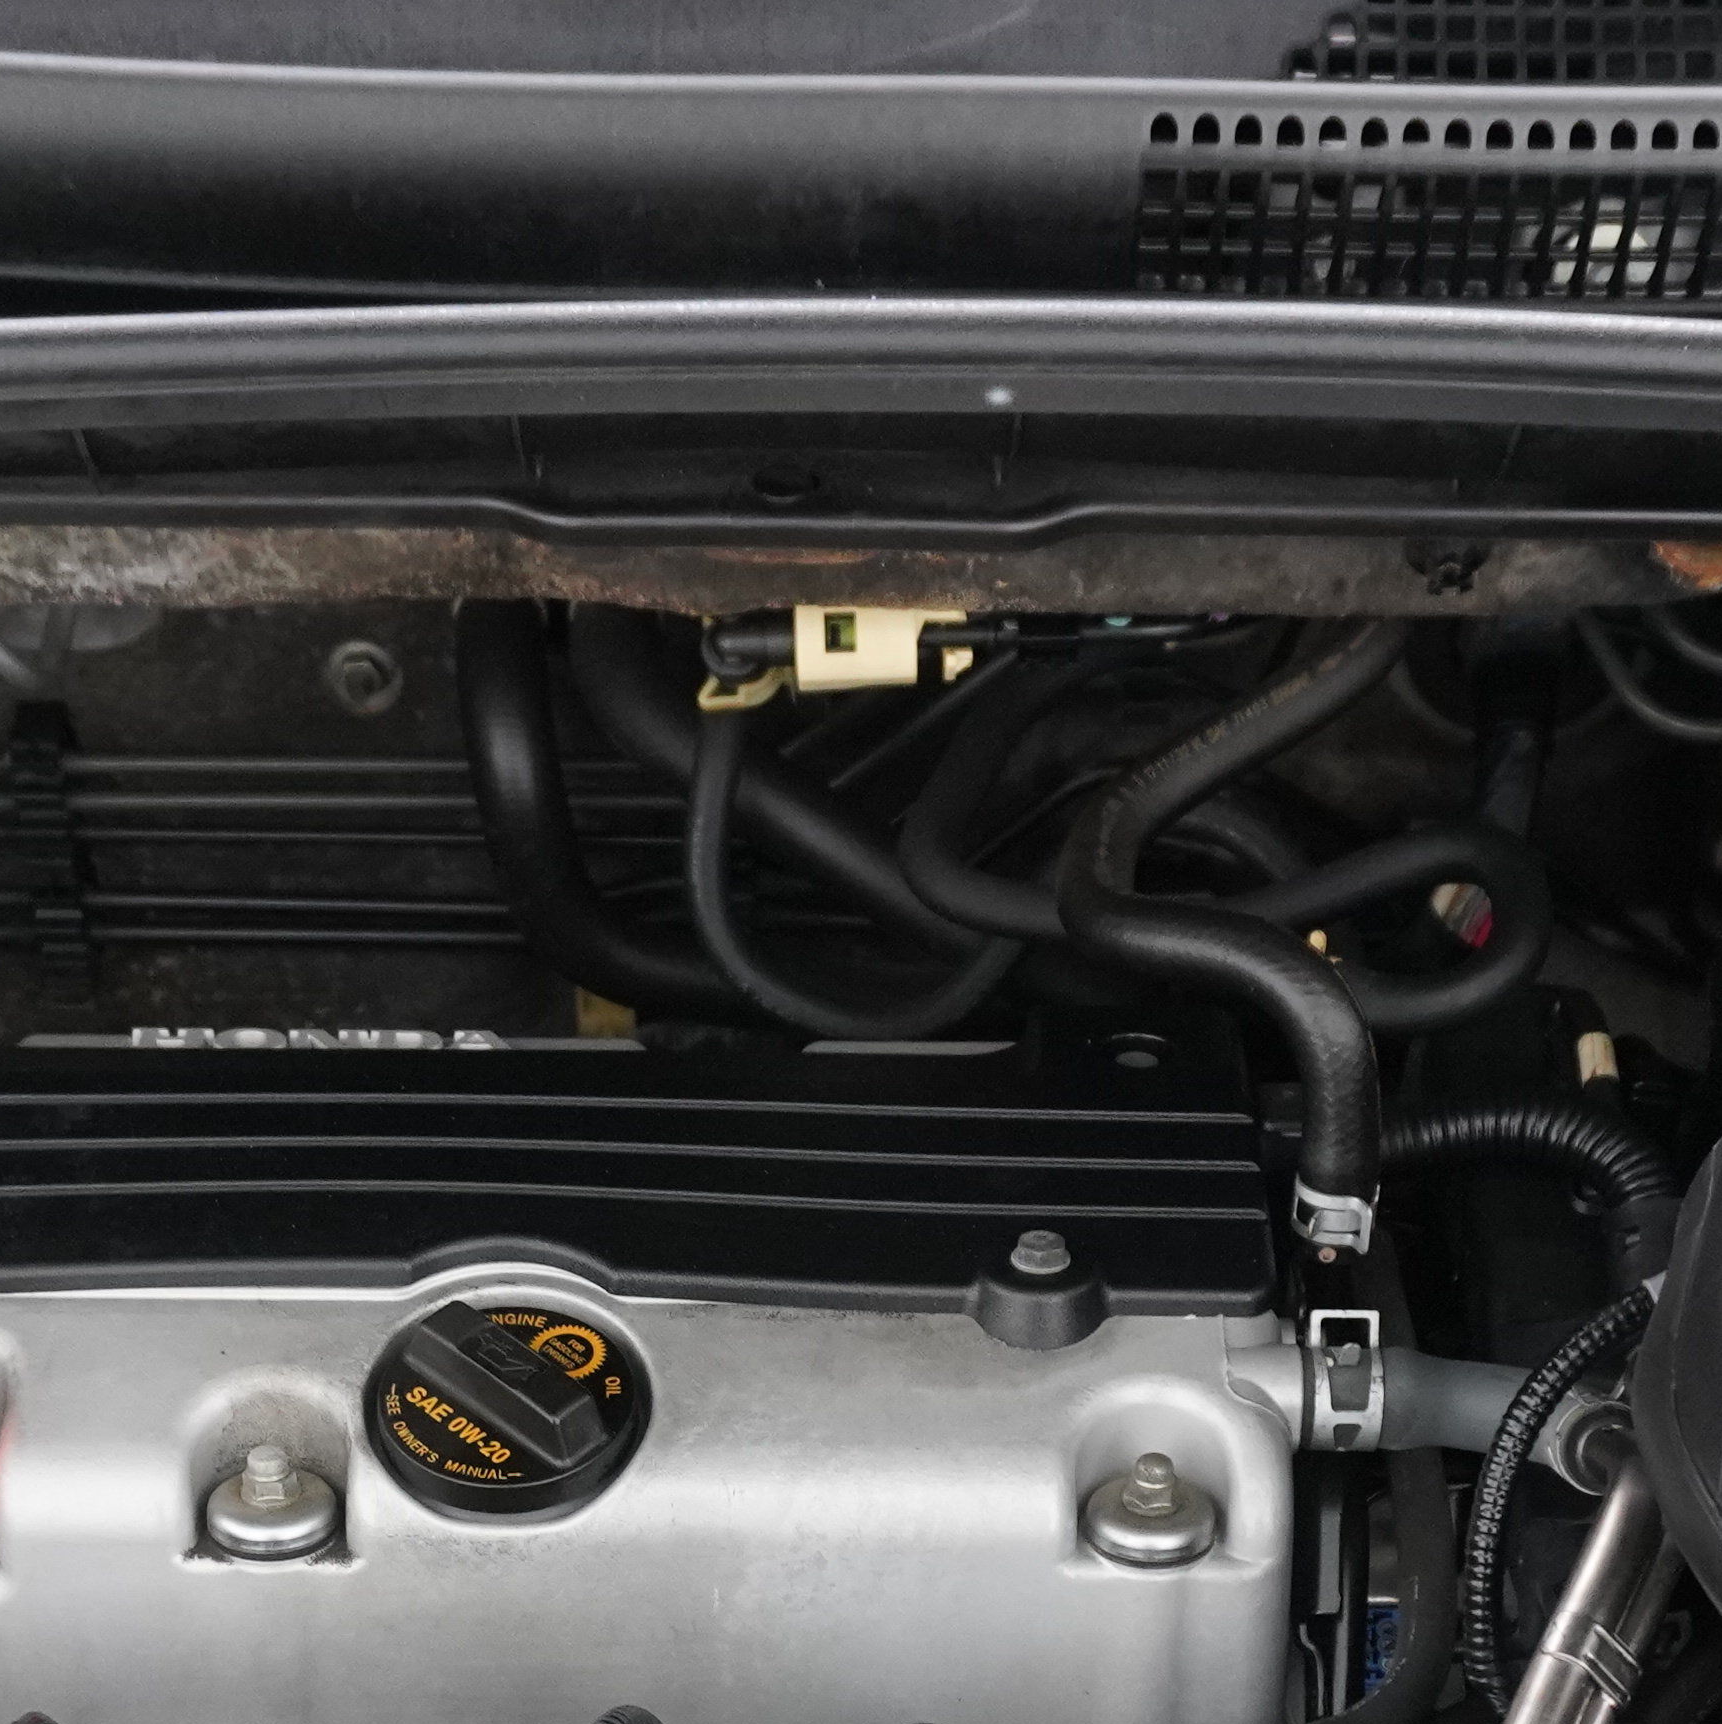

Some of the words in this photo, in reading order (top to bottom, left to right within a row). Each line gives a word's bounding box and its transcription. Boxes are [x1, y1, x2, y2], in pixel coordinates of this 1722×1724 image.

[549, 1337, 586, 1366] GASOLINE
[568, 1338, 585, 1353] FOR
[605, 1376, 621, 1399] OIL
[385, 1393, 402, 1416] SEE
[405, 1384, 454, 1423] SAE
[448, 1416, 511, 1464] 0W-20
[393, 1421, 439, 1464] OWNER'S
[444, 1459, 507, 1480] MANUAL
